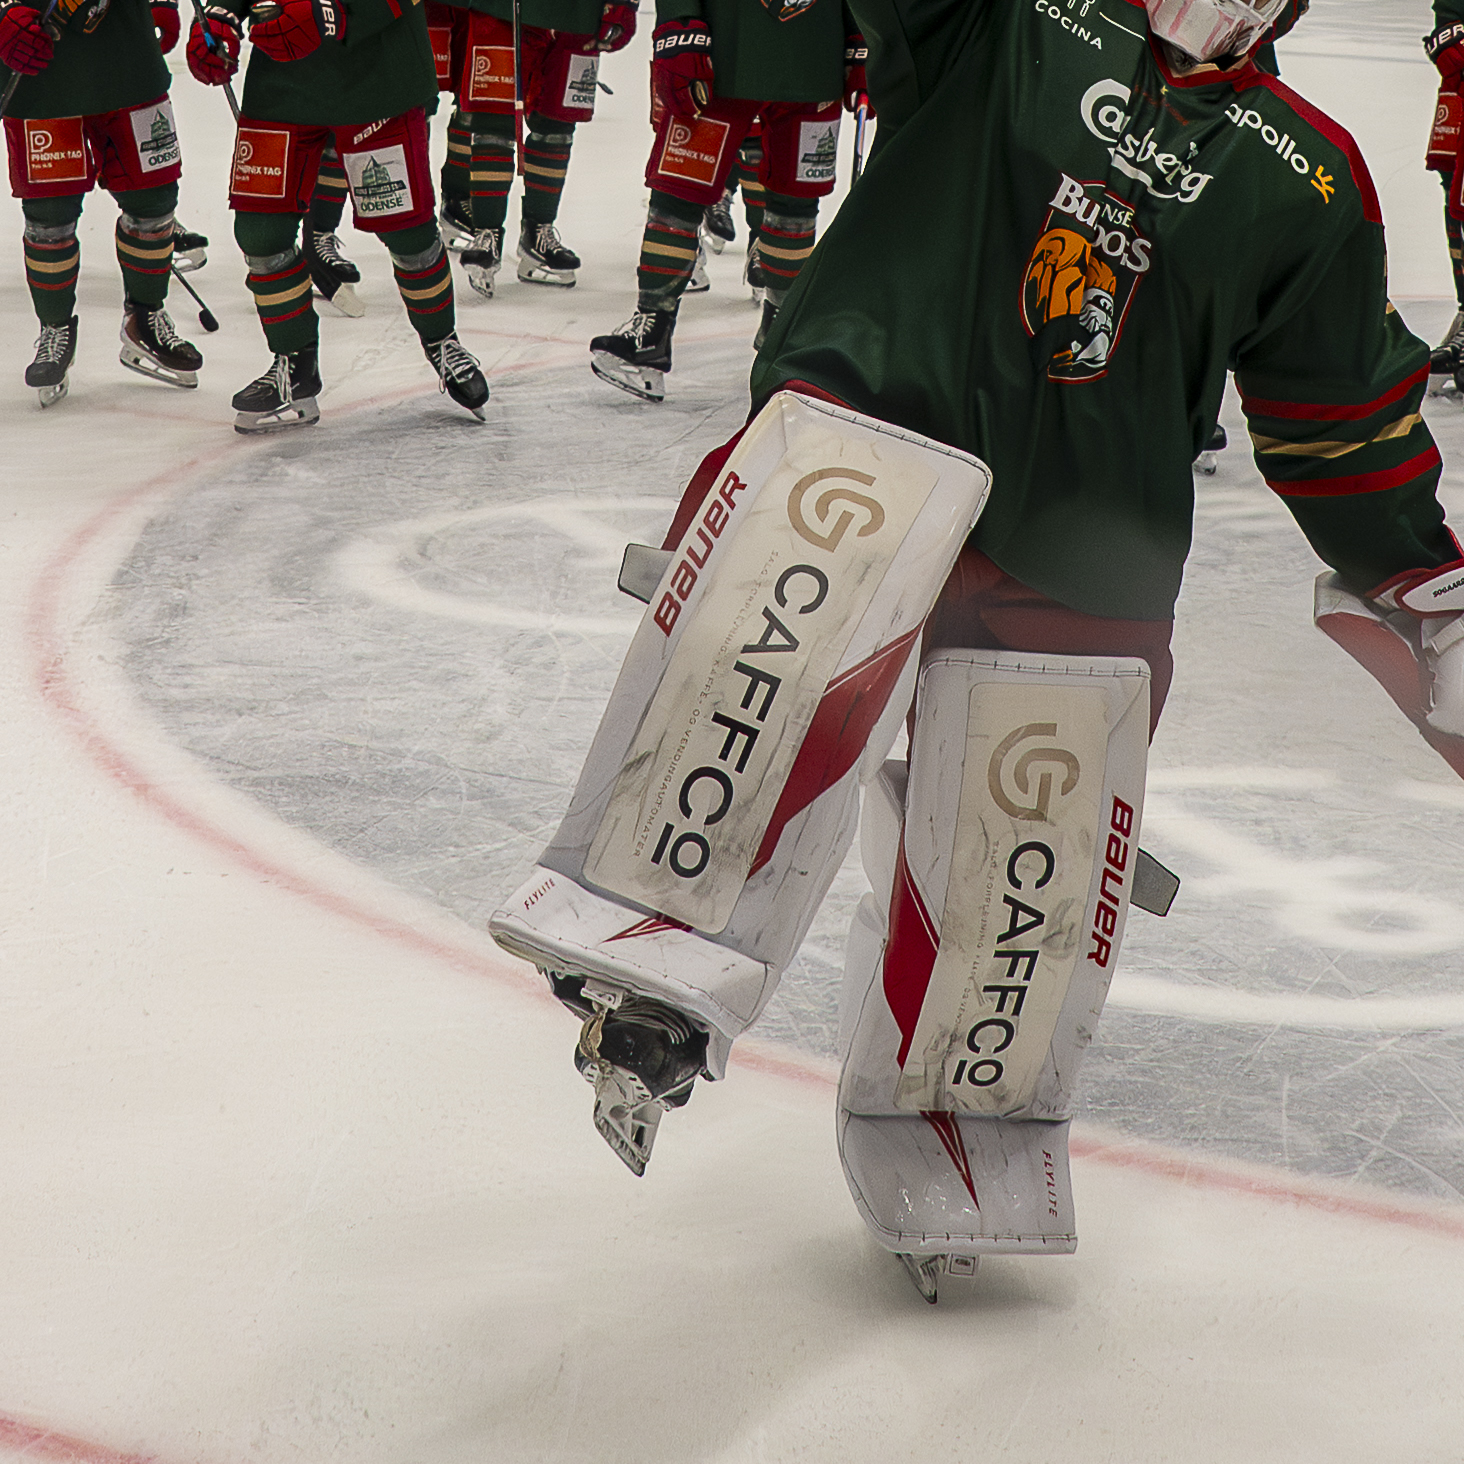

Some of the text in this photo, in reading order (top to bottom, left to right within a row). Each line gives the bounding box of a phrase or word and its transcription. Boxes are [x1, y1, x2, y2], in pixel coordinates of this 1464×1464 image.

[1225, 103, 1310, 175] apollo
[360, 197, 404, 213] ODENSE
[653, 470, 748, 638] BAUER
[523, 876, 556, 910] FLYLITE
[1086, 794, 1134, 968] BAUER
[1040, 1148, 1060, 1218] FLYLITE
